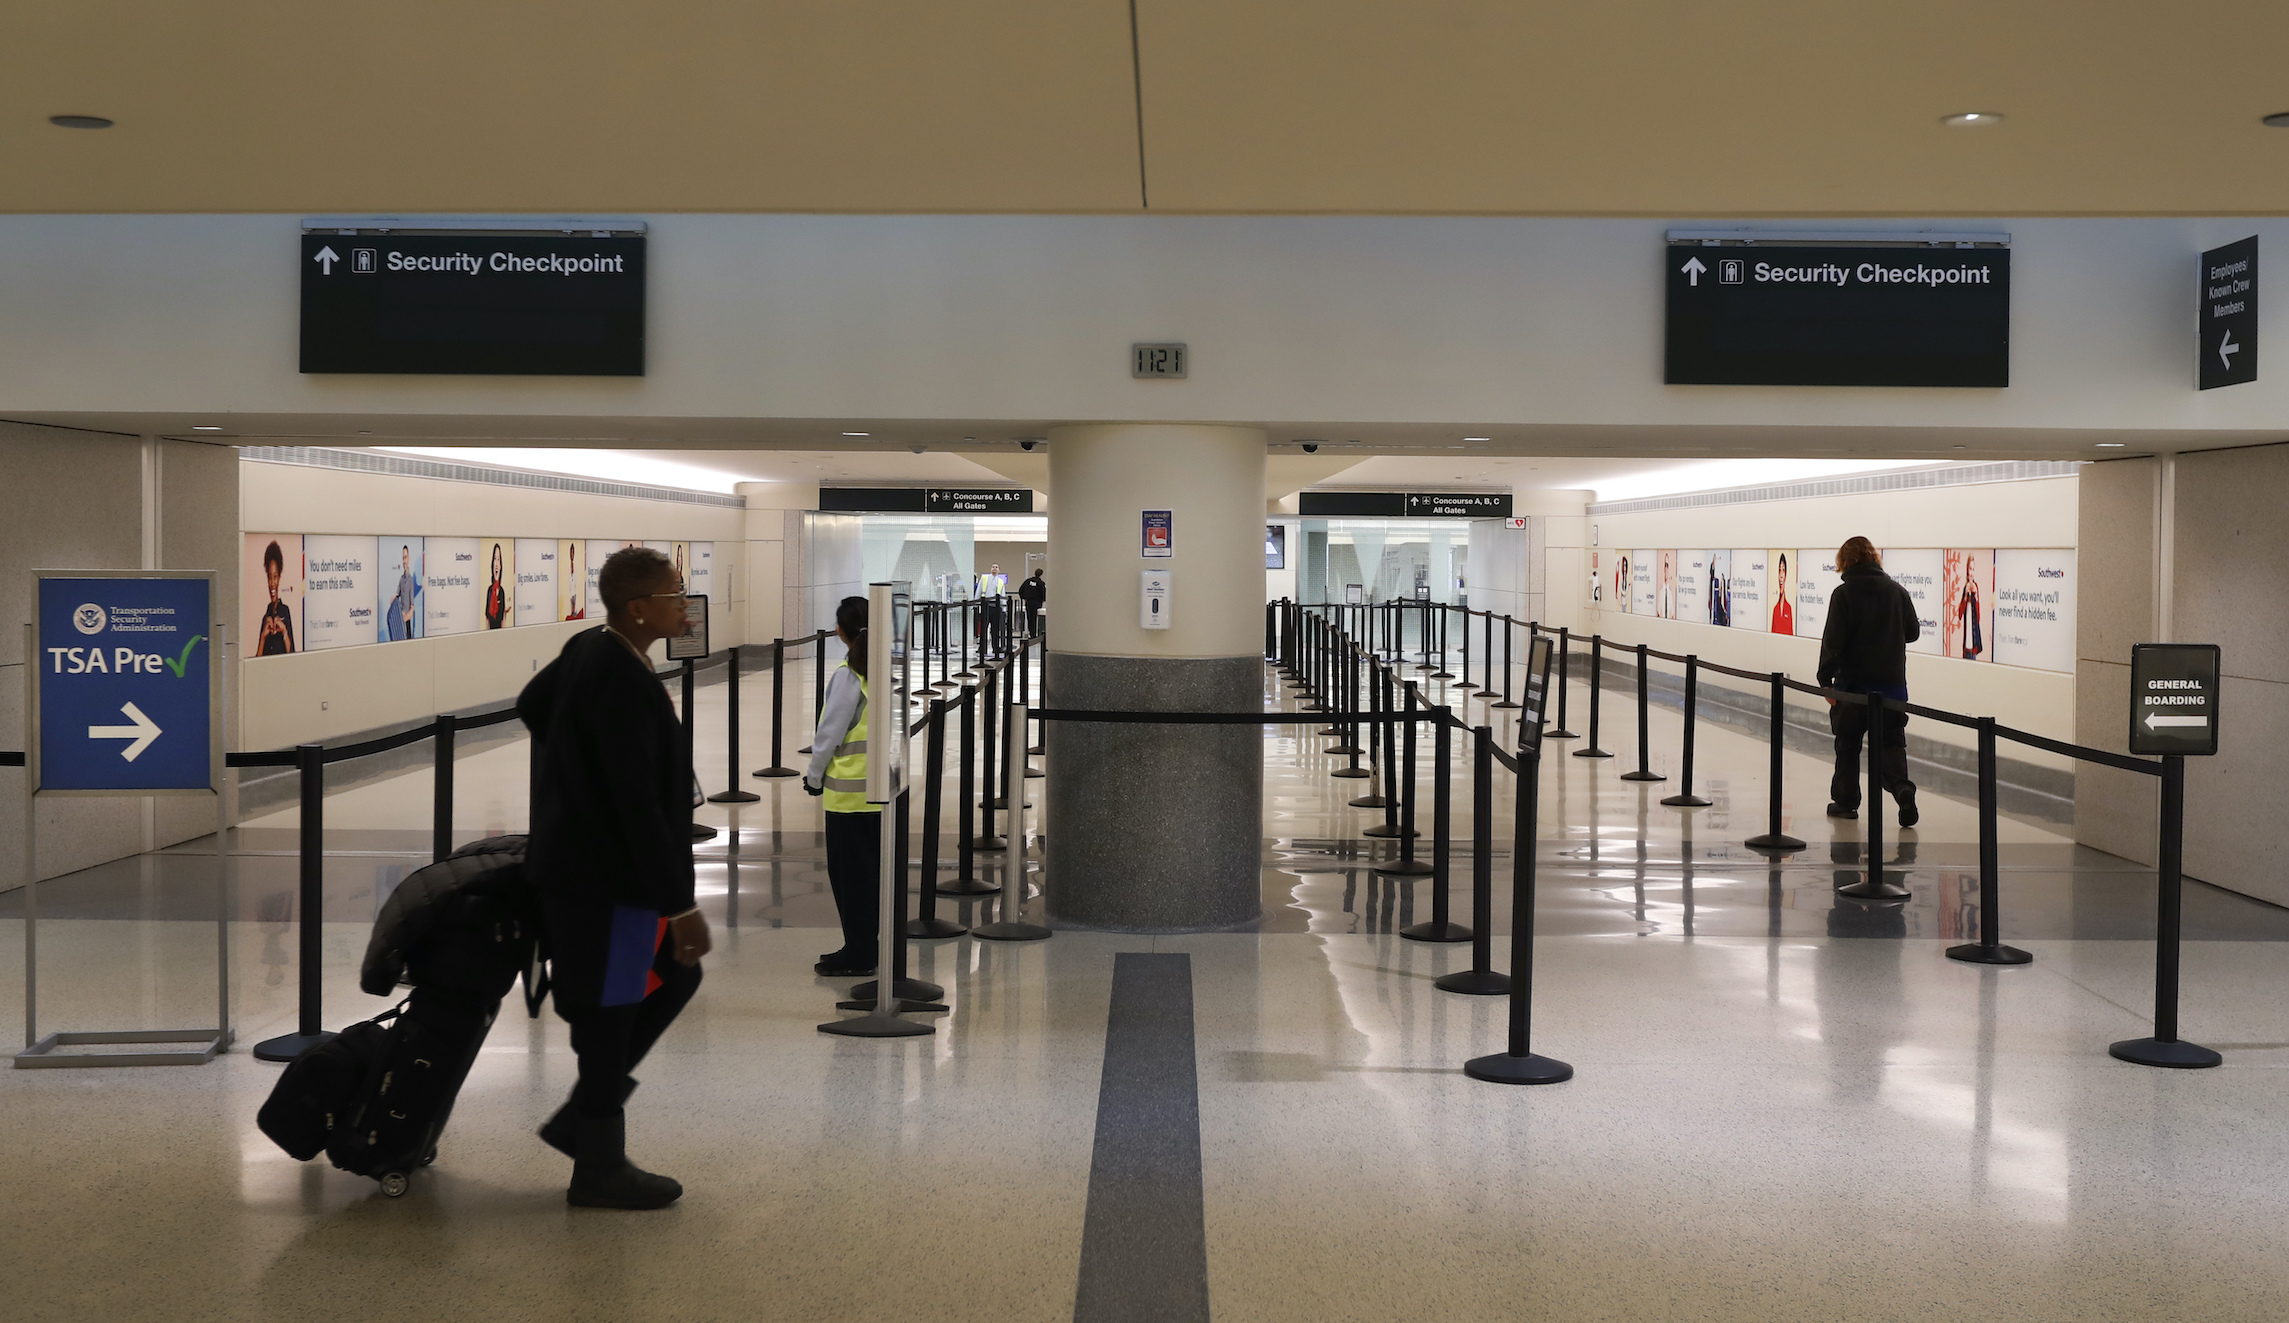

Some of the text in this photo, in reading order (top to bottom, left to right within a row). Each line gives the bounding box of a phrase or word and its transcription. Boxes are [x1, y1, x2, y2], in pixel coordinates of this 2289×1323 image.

[387, 250, 624, 276] Security Checkpoint
[1754, 260, 1990, 287] Security Checkpoint
[2208, 279, 2250, 300] Known Crew
[2213, 300, 2245, 318] Members
[953, 492, 1020, 502] Concourse A, B, C
[1474, 498, 1483, 506] A,
[1484, 498, 1492, 506] B,
[953, 502, 986, 510] All Gates
[309, 559, 361, 573] You don't need miles
[2038, 567, 2062, 579] Southwest
[309, 577, 354, 590] to earn this smile.
[1900, 573, 1912, 586] flights
[1913, 573, 1924, 585] make
[1924, 576, 1932, 587] you
[1999, 588, 2011, 600] Look
[2019, 591, 2028, 603] you
[2029, 591, 2043, 605] want,
[2043, 590, 2059, 606] you'll
[110, 606, 175, 616] Transportation
[349, 607, 370, 618] Southwest
[1999, 607, 2012, 617] never
[2013, 605, 2023, 618] find
[2028, 607, 2046, 620] hidden
[2047, 608, 2057, 621] fee.
[110, 615, 148, 624] Security
[110, 624, 177, 632] Administration
[47, 647, 163, 674] TSA Pre
[2148, 680, 2202, 690] GENERAL
[2144, 696, 2206, 706] BOARDING
